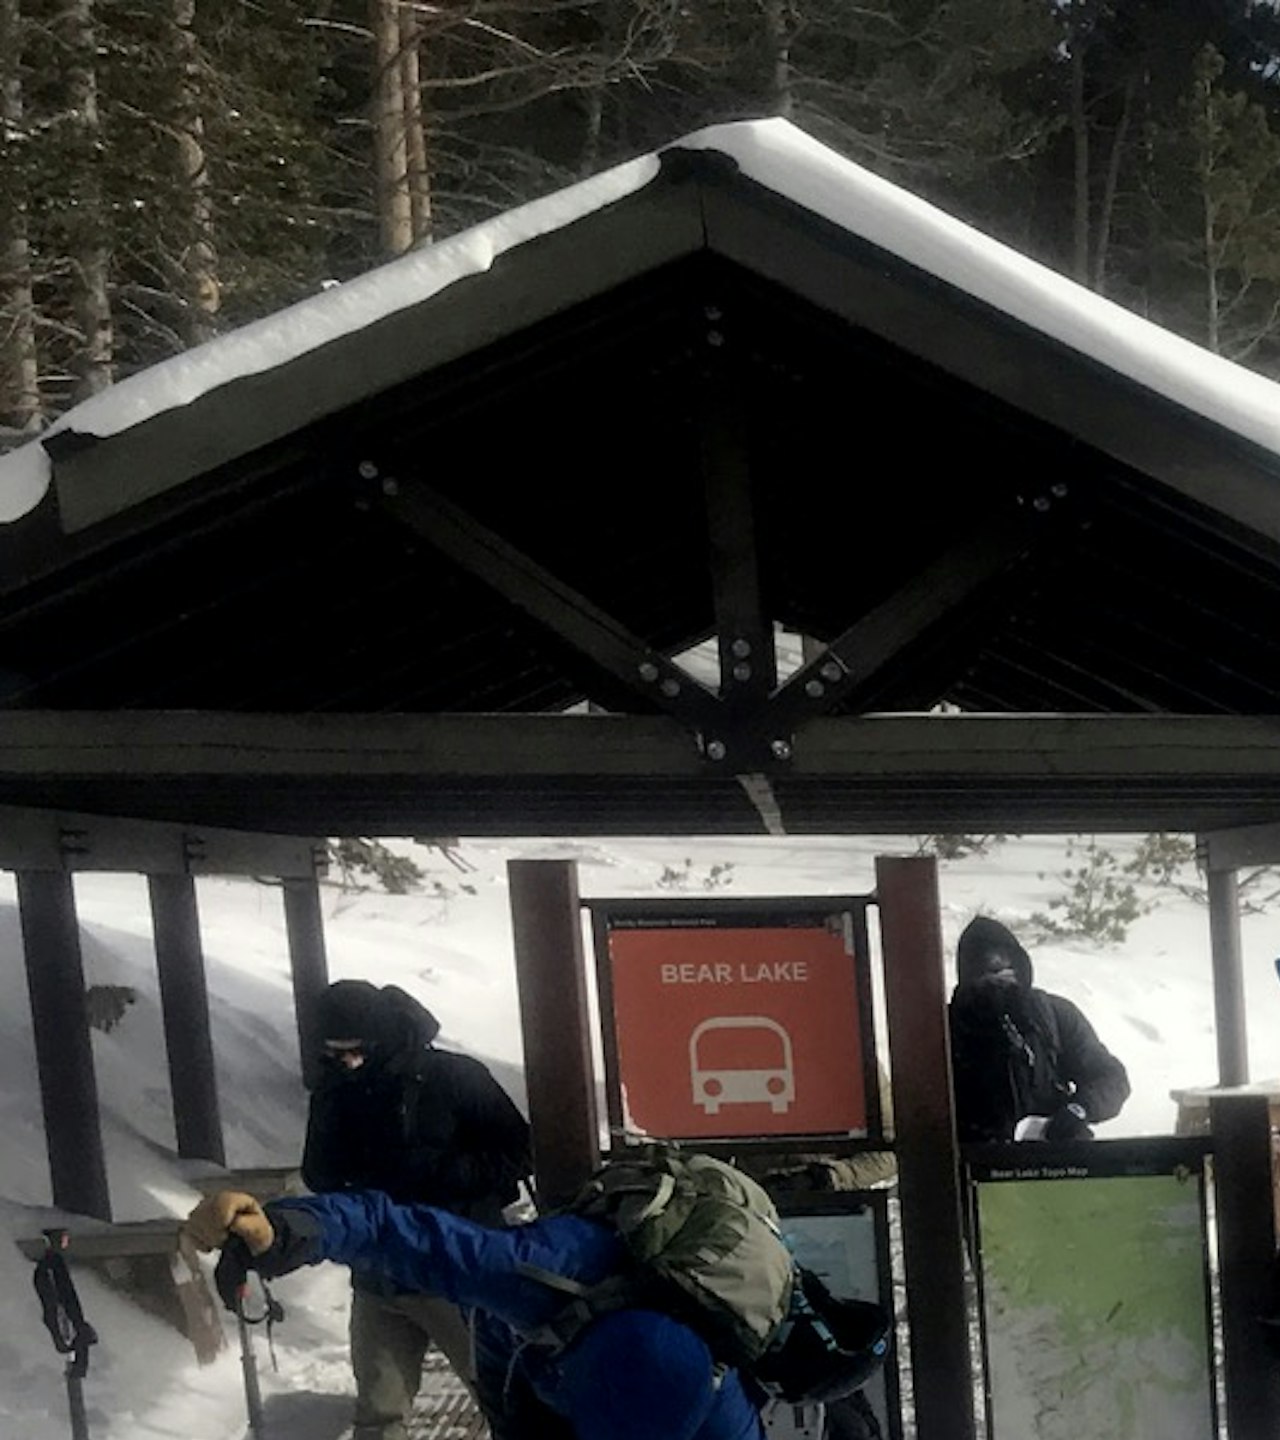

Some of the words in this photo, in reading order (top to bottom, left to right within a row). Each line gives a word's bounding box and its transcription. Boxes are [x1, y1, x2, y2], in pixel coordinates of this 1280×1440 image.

[661, 963, 733, 984] BEAR
[740, 961, 808, 982] LAKE
[990, 1169, 1014, 1178] Bear
[1016, 1168, 1039, 1178] Lake
[1067, 1167, 1088, 1177] Map
